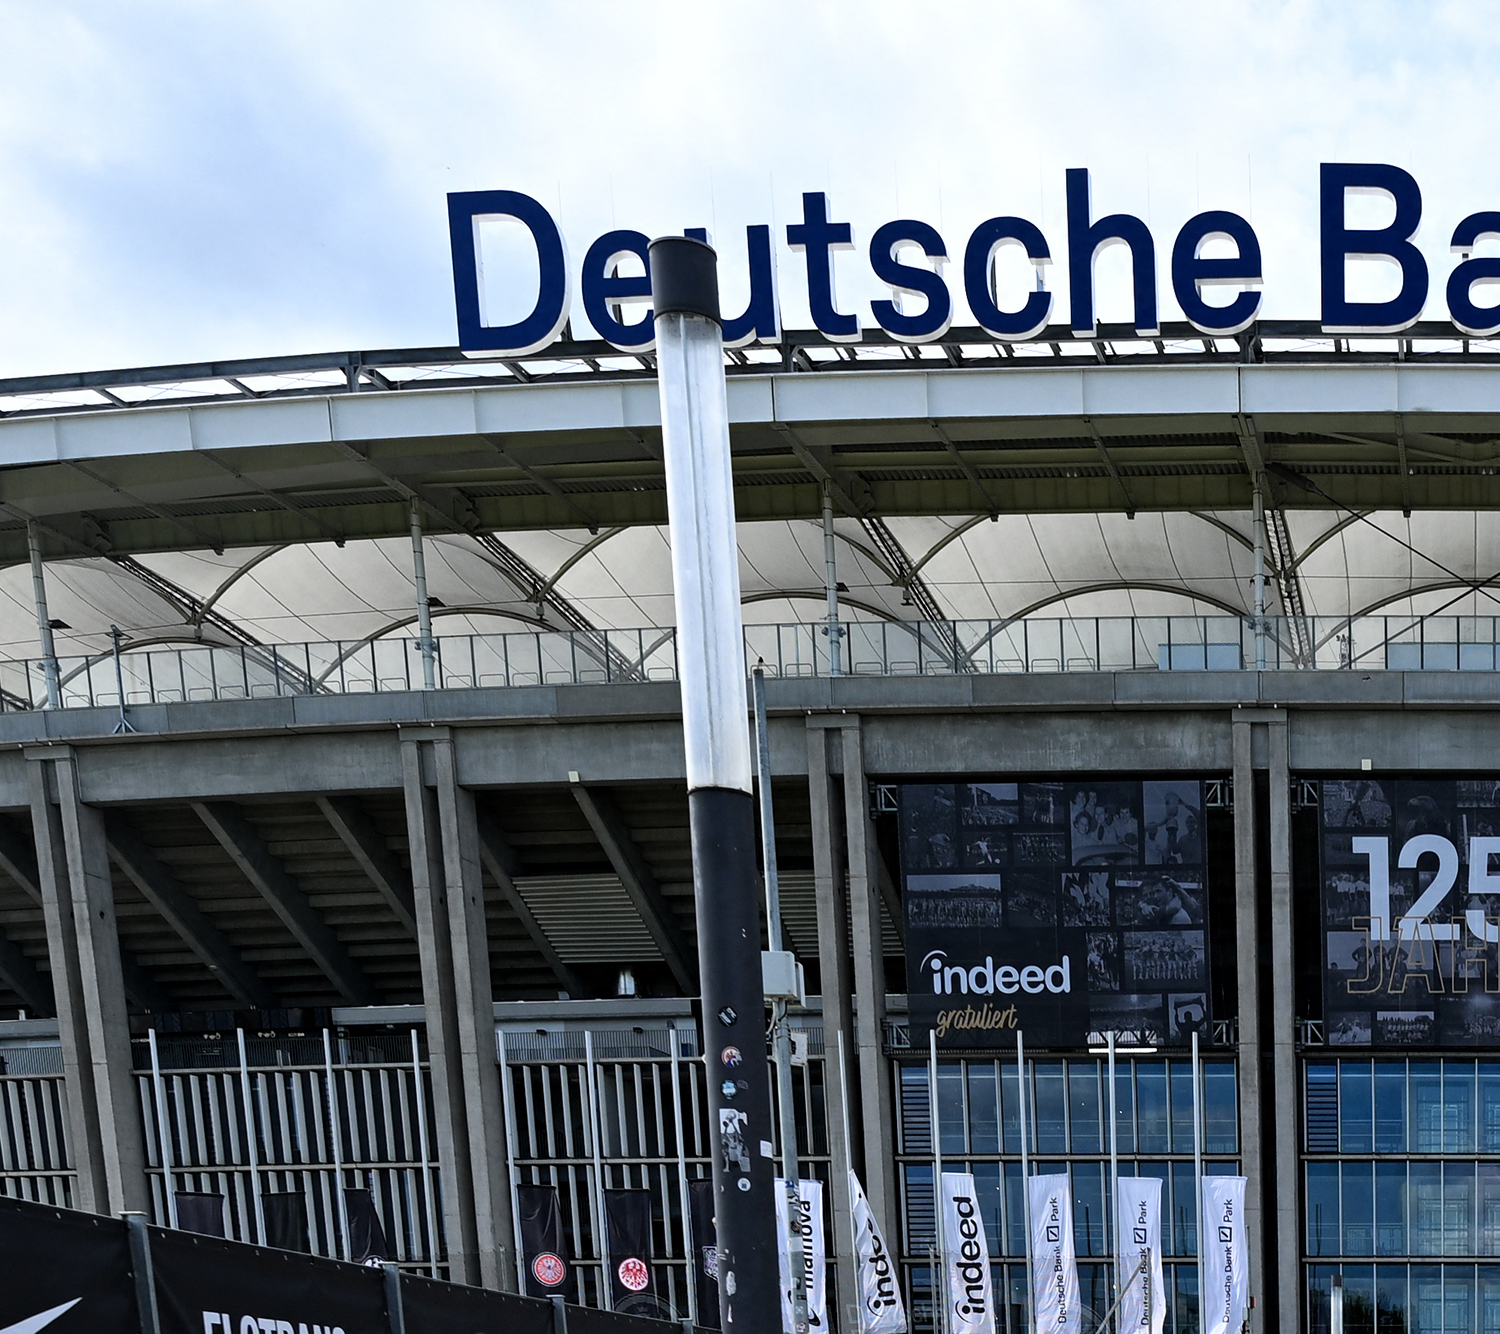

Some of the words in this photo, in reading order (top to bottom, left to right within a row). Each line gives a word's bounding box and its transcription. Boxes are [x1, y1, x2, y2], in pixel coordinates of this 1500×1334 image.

[446, 167, 1264, 356] Deutsche
[920, 950, 1071, 995] indeed
[935, 1003, 1018, 1038] gratuliert
[1050, 1197, 1060, 1222] Park
[1138, 1200, 1147, 1225] Park
[1223, 1198, 1233, 1223] Park
[952, 1196, 986, 1324] indeed
